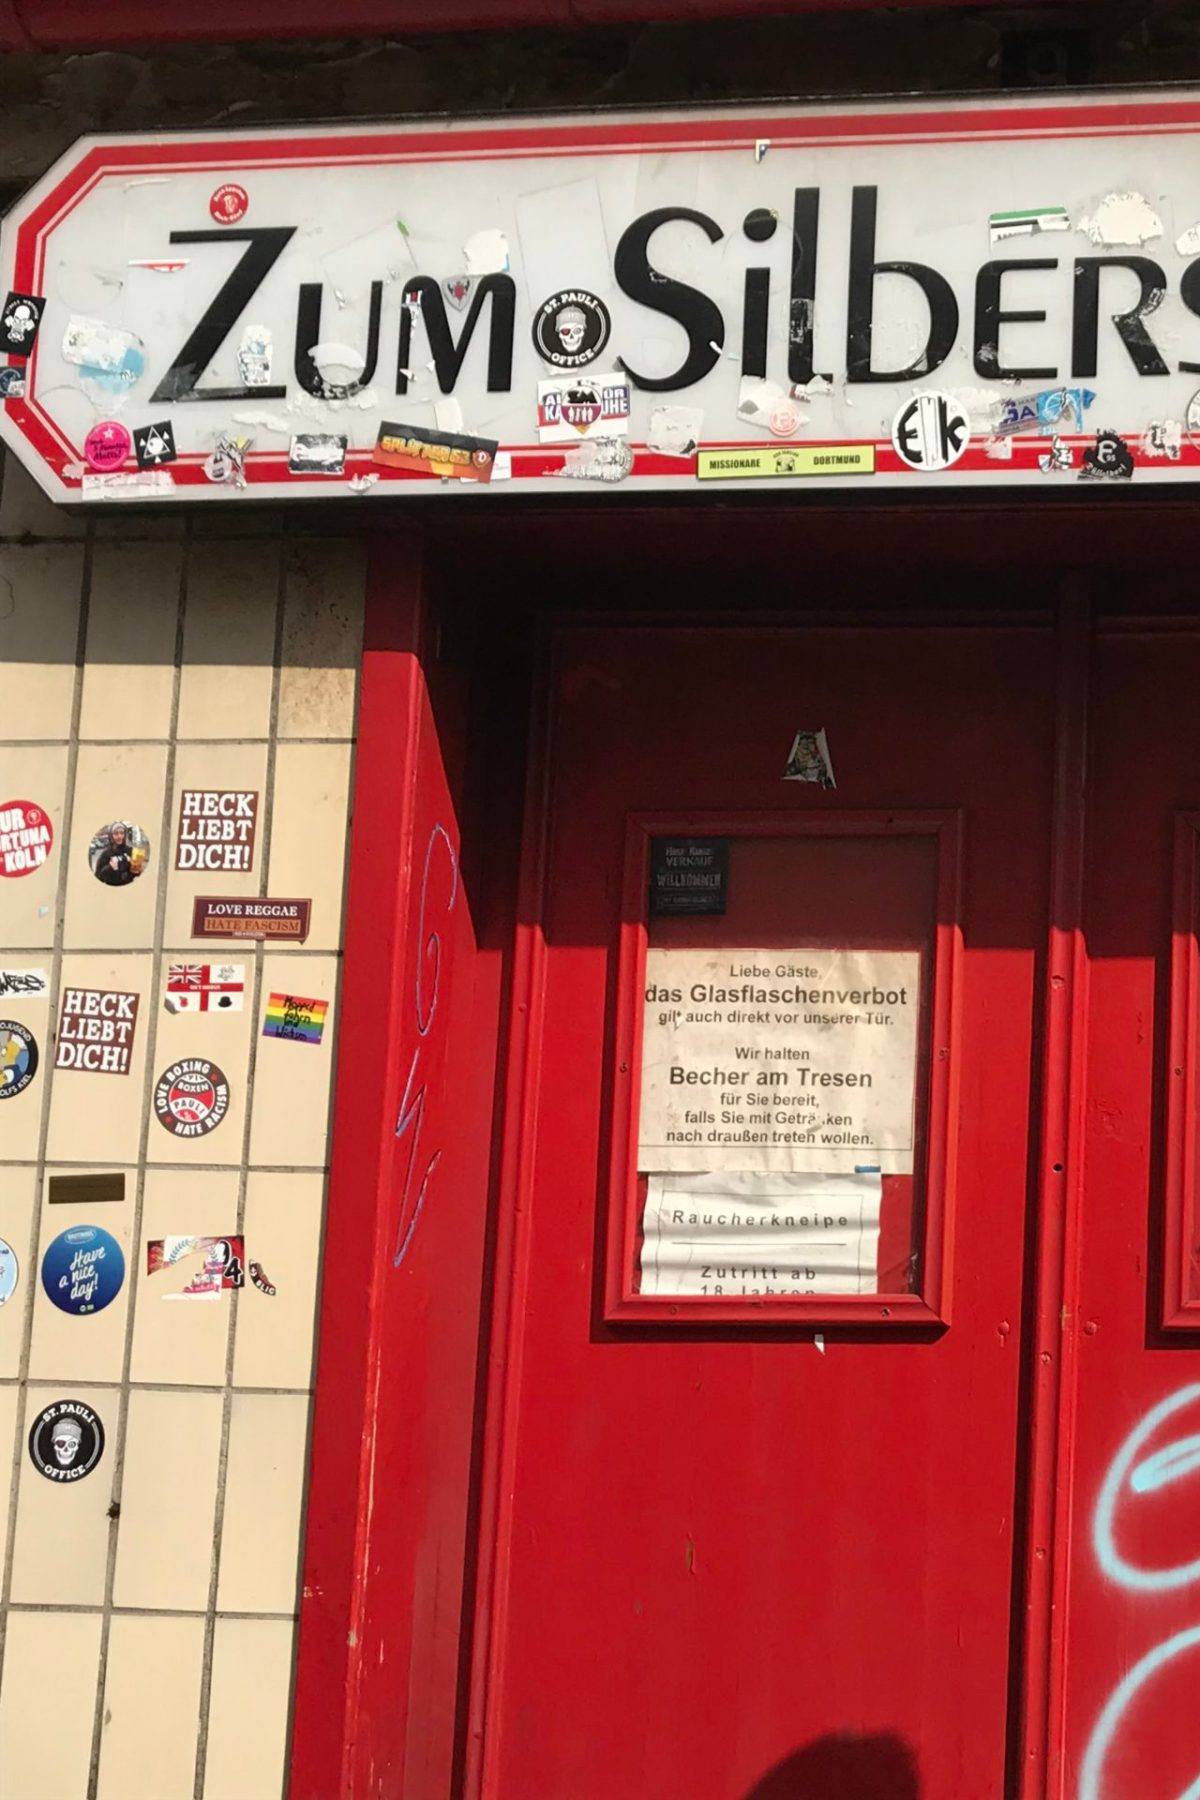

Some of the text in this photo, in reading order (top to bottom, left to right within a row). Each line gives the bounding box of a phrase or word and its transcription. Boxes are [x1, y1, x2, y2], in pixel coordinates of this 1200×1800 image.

[543, 292, 599, 315] ST. PAULI
[551, 347, 595, 366] OFFICE
[812, 453, 861, 466] DORTMUND
[182, 792, 255, 817] HECK
[180, 819, 252, 842] LIEBT
[5, 842, 47, 873] KÖLN
[177, 844, 251, 871] DICH!
[207, 903, 299, 917] LOVE REGGAE
[206, 918, 300, 932] HATE FASCISM
[729, 964, 823, 981] Liebe Gäste,
[644, 983, 908, 1006] das Glasflaschenverbot
[64, 991, 136, 1019] HECK
[685, 1009, 723, 1024] auch
[726, 1010, 771, 1025] direkt
[774, 1012, 799, 1025] vor
[803, 1012, 861, 1026] unserer
[864, 1011, 894, 1026] Tür.
[60, 1017, 133, 1043] LIEBT
[56, 1042, 129, 1073] DICH!
[734, 1046, 811, 1061] Wir halten
[156, 1060, 211, 1114] LOVE BOXING
[668, 1066, 873, 1088] Becher am Tresen
[177, 1083, 210, 1094] BOXEN
[173, 1100, 206, 1114] PAULI
[174, 1083, 228, 1137] HATE RACISM
[719, 1092, 820, 1109] für Sie bereit,
[684, 1110, 853, 1127] falls Sie mit Geträken
[665, 1129, 874, 1145] nach draußen treten wollen.
[672, 1210, 849, 1230] Raucherkneipe
[69, 1246, 106, 1272] Have
[71, 1265, 97, 1284] nice
[700, 1266, 817, 1282] Zutritt ab
[70, 1272, 98, 1302] day!
[42, 1402, 96, 1425] ST. PAULI
[43, 1463, 87, 1481] OFFICE
